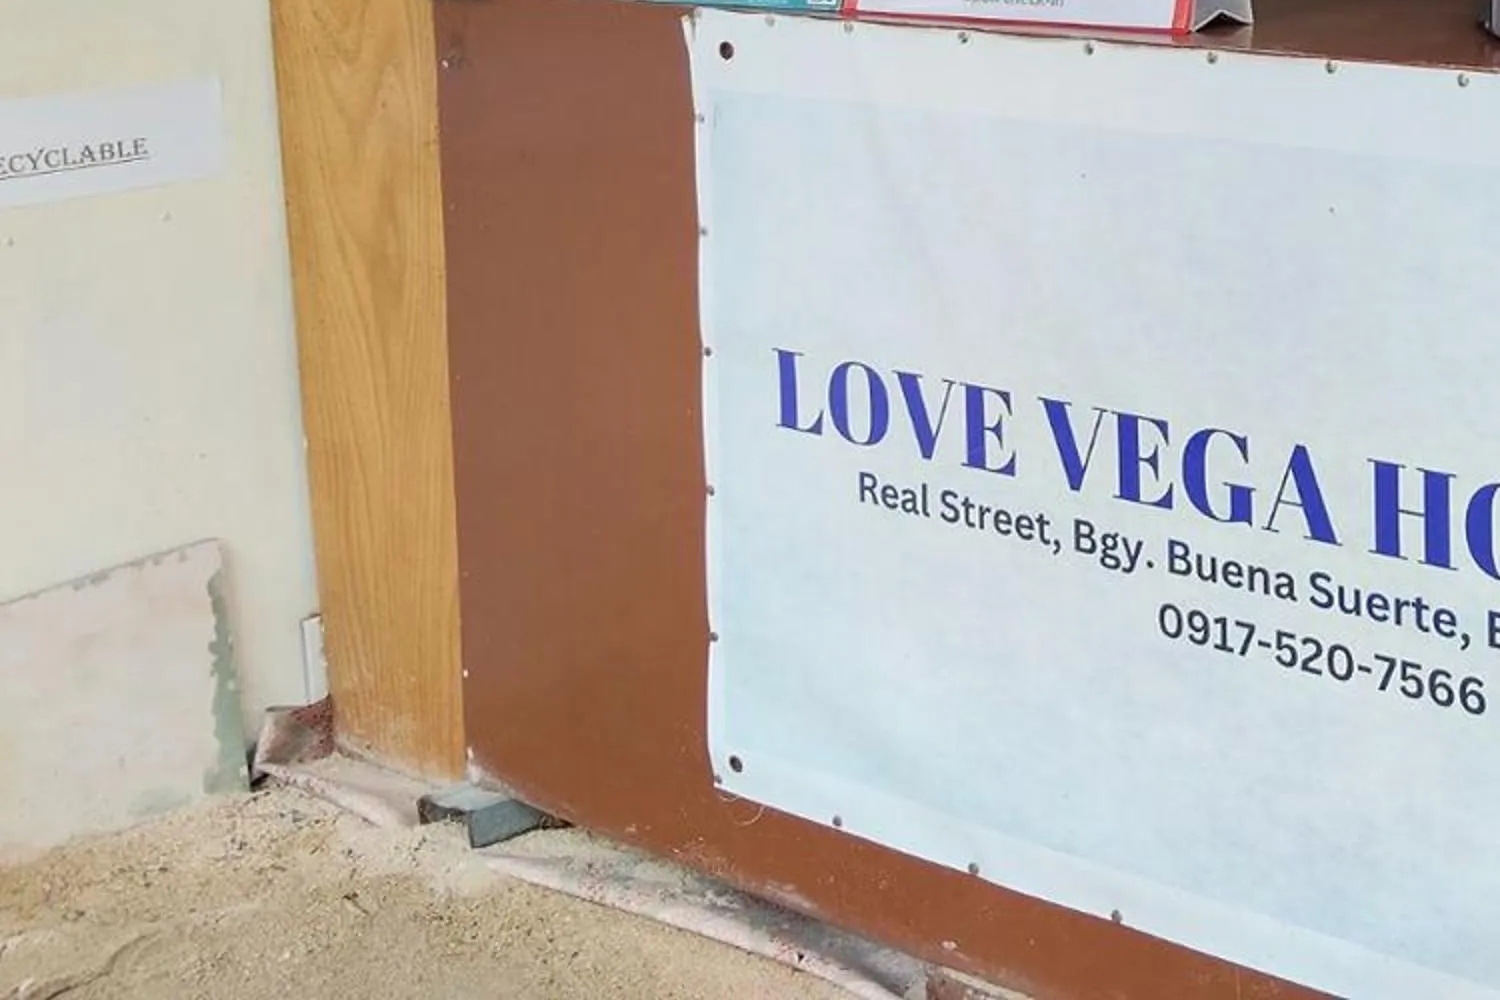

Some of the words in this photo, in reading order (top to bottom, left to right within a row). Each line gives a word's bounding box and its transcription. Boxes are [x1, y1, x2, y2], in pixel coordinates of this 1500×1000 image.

[772, 347, 1017, 477] LOVE
[1037, 395, 1343, 547] VEGA
[857, 471, 931, 519] Real
[939, 489, 1062, 555] Street,
[1073, 518, 1155, 574] Bgy.
[1167, 537, 1298, 602] Buena
[1308, 570, 1473, 652] Suerte,
[1157, 602, 1488, 717] 0917-520-7566
